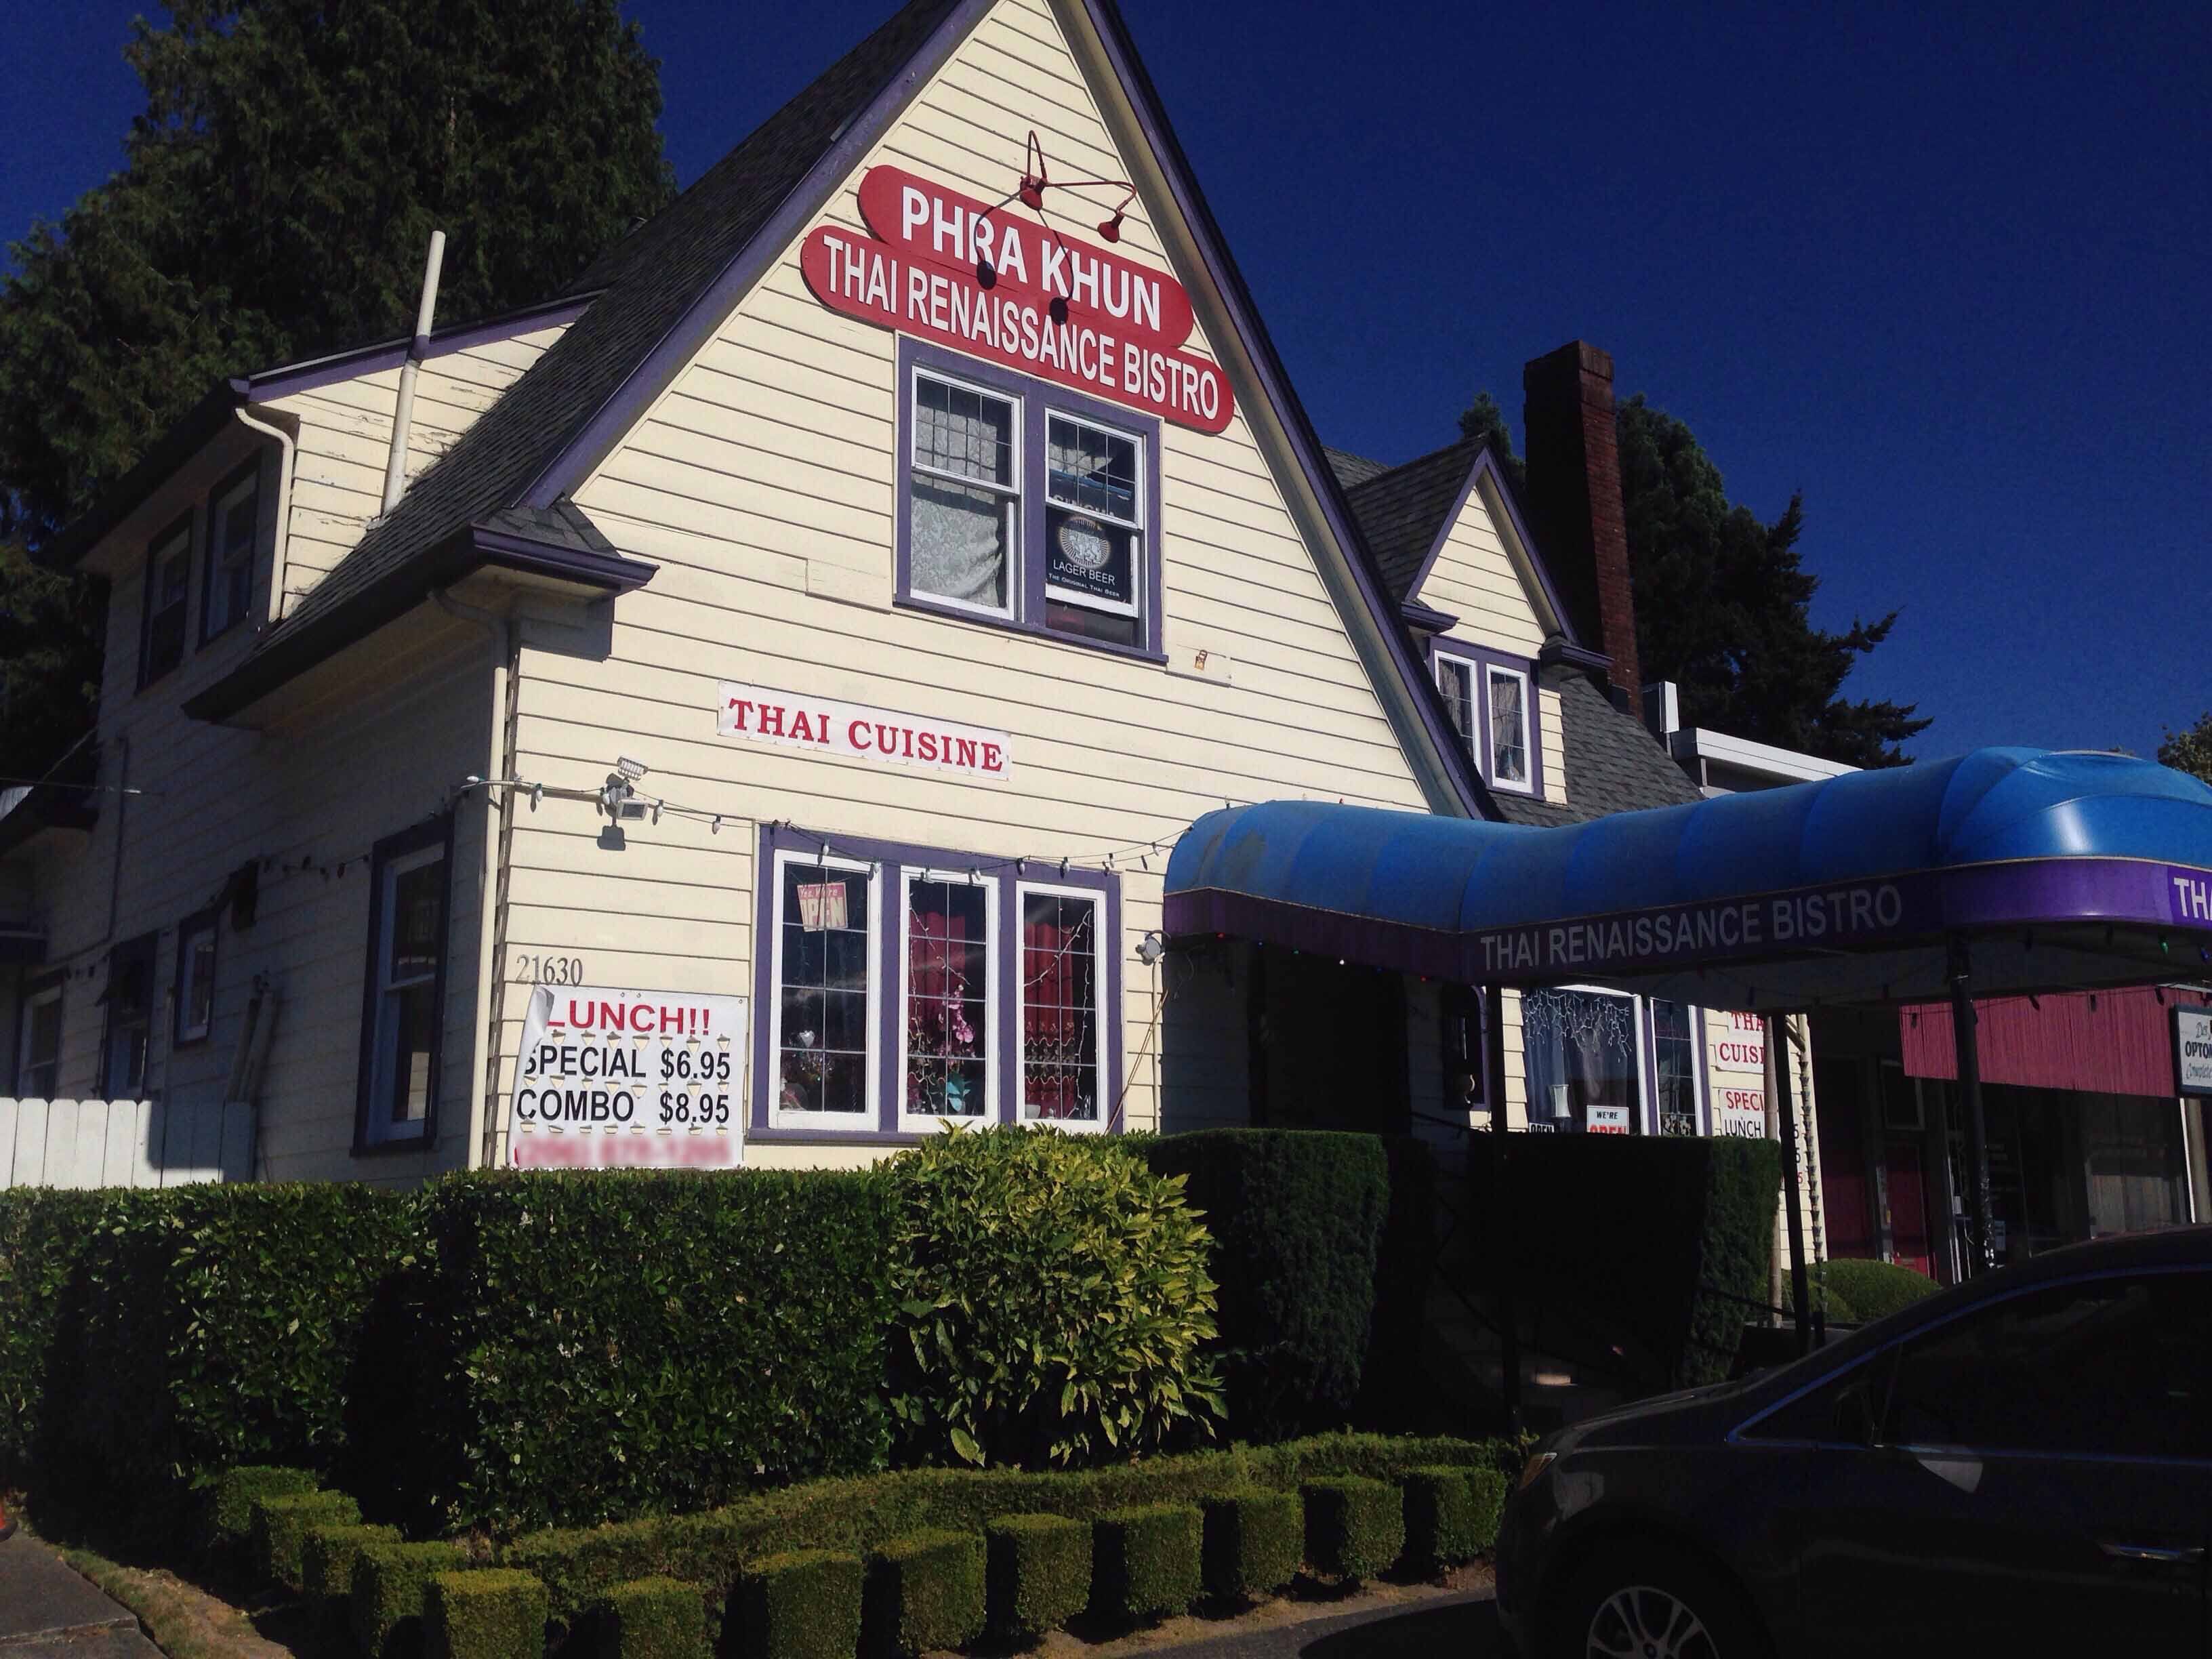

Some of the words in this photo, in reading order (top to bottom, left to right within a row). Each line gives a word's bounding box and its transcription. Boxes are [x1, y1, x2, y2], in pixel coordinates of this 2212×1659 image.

[901, 186, 1027, 283] PHRA
[1042, 239, 1160, 331] KHUN
[823, 234, 897, 314] THAI
[907, 266, 1115, 386] RENAISSANCE
[1123, 342, 1219, 420] BISTRO
[1052, 558, 1087, 578] LAGER
[1088, 569, 1115, 586] BEER
[729, 698, 830, 744] THAI
[847, 720, 1003, 772] CUISINE
[2173, 877, 2212, 923] TH
[1480, 933, 1540, 971] THAI
[1549, 903, 1762, 965] RENAISSANCE
[1771, 884, 1902, 941] BISTRO
[515, 954, 583, 987] 21630
[660, 1047, 731, 1081] $6.95
[516, 1088, 634, 1122] COMBO
[659, 1090, 730, 1125] $8.95
[1596, 1111, 1618, 1120] WE'RE
[1725, 1119, 1761, 1138] LUNCH
